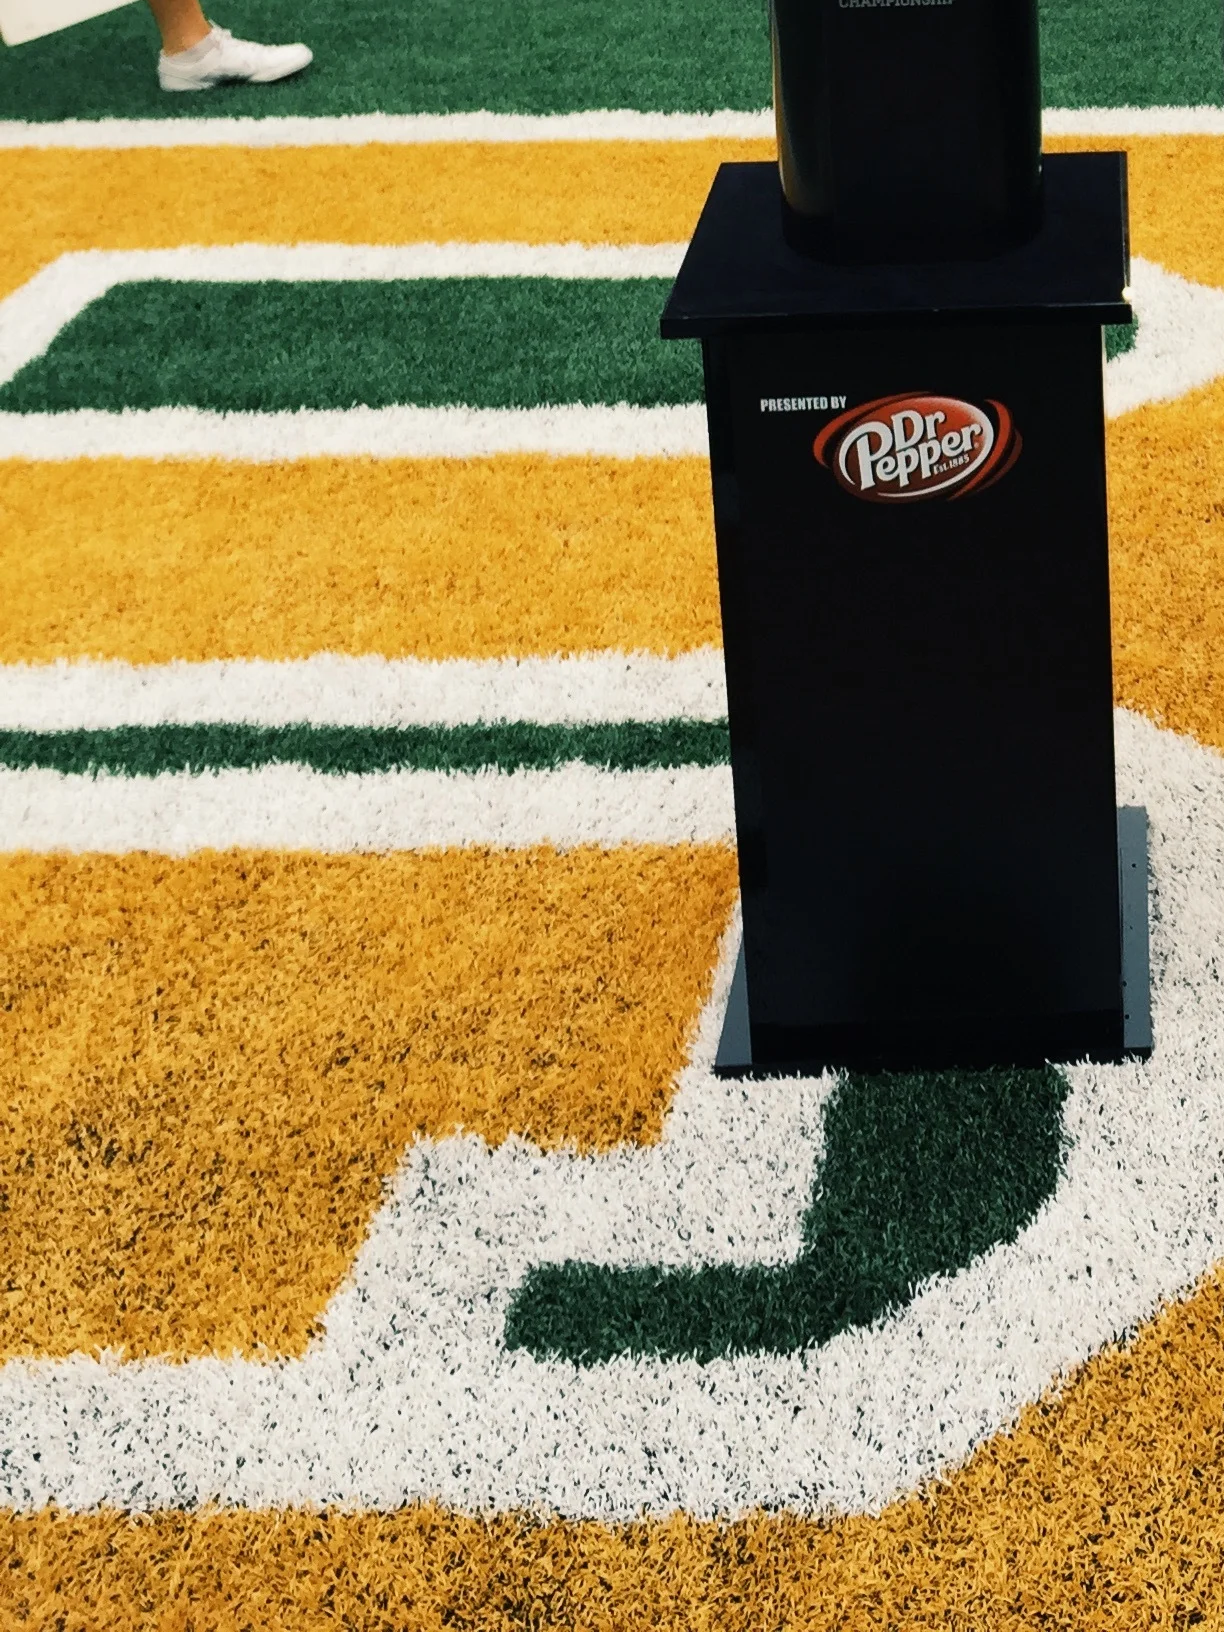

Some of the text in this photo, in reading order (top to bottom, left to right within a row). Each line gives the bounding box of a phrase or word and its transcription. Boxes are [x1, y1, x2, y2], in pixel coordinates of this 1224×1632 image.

[760, 395, 847, 412] PRESENTED BY
[891, 409, 945, 453] Dr
[845, 420, 982, 490] Pepper
